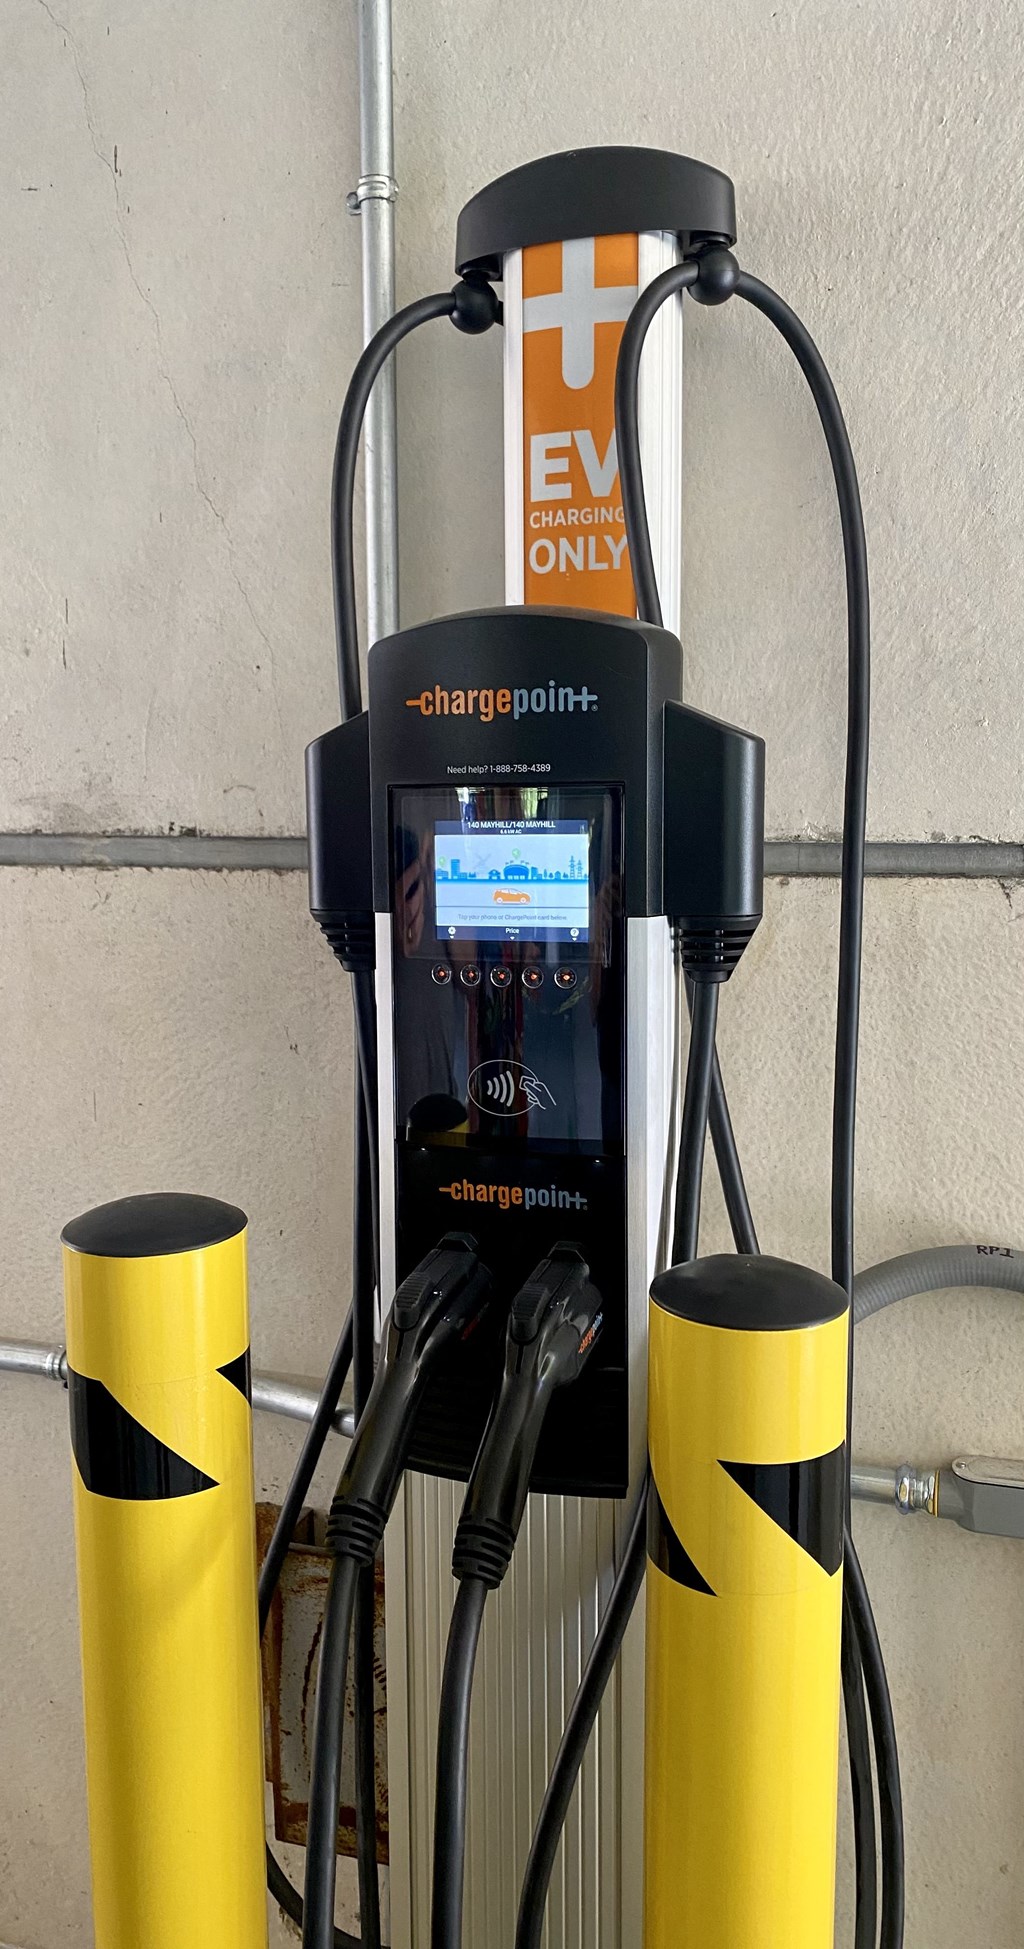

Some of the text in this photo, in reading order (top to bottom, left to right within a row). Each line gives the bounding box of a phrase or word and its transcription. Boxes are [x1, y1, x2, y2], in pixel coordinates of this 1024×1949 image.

[530, 427, 620, 502] EV
[529, 534, 629, 574] ONLY
[447, 764, 551, 775] Need help? 1-888-758-4389
[468, 820, 556, 829] 140 MAYHILL/140 MAYHILL
[976, 1244, 1015, 1259] RP1
